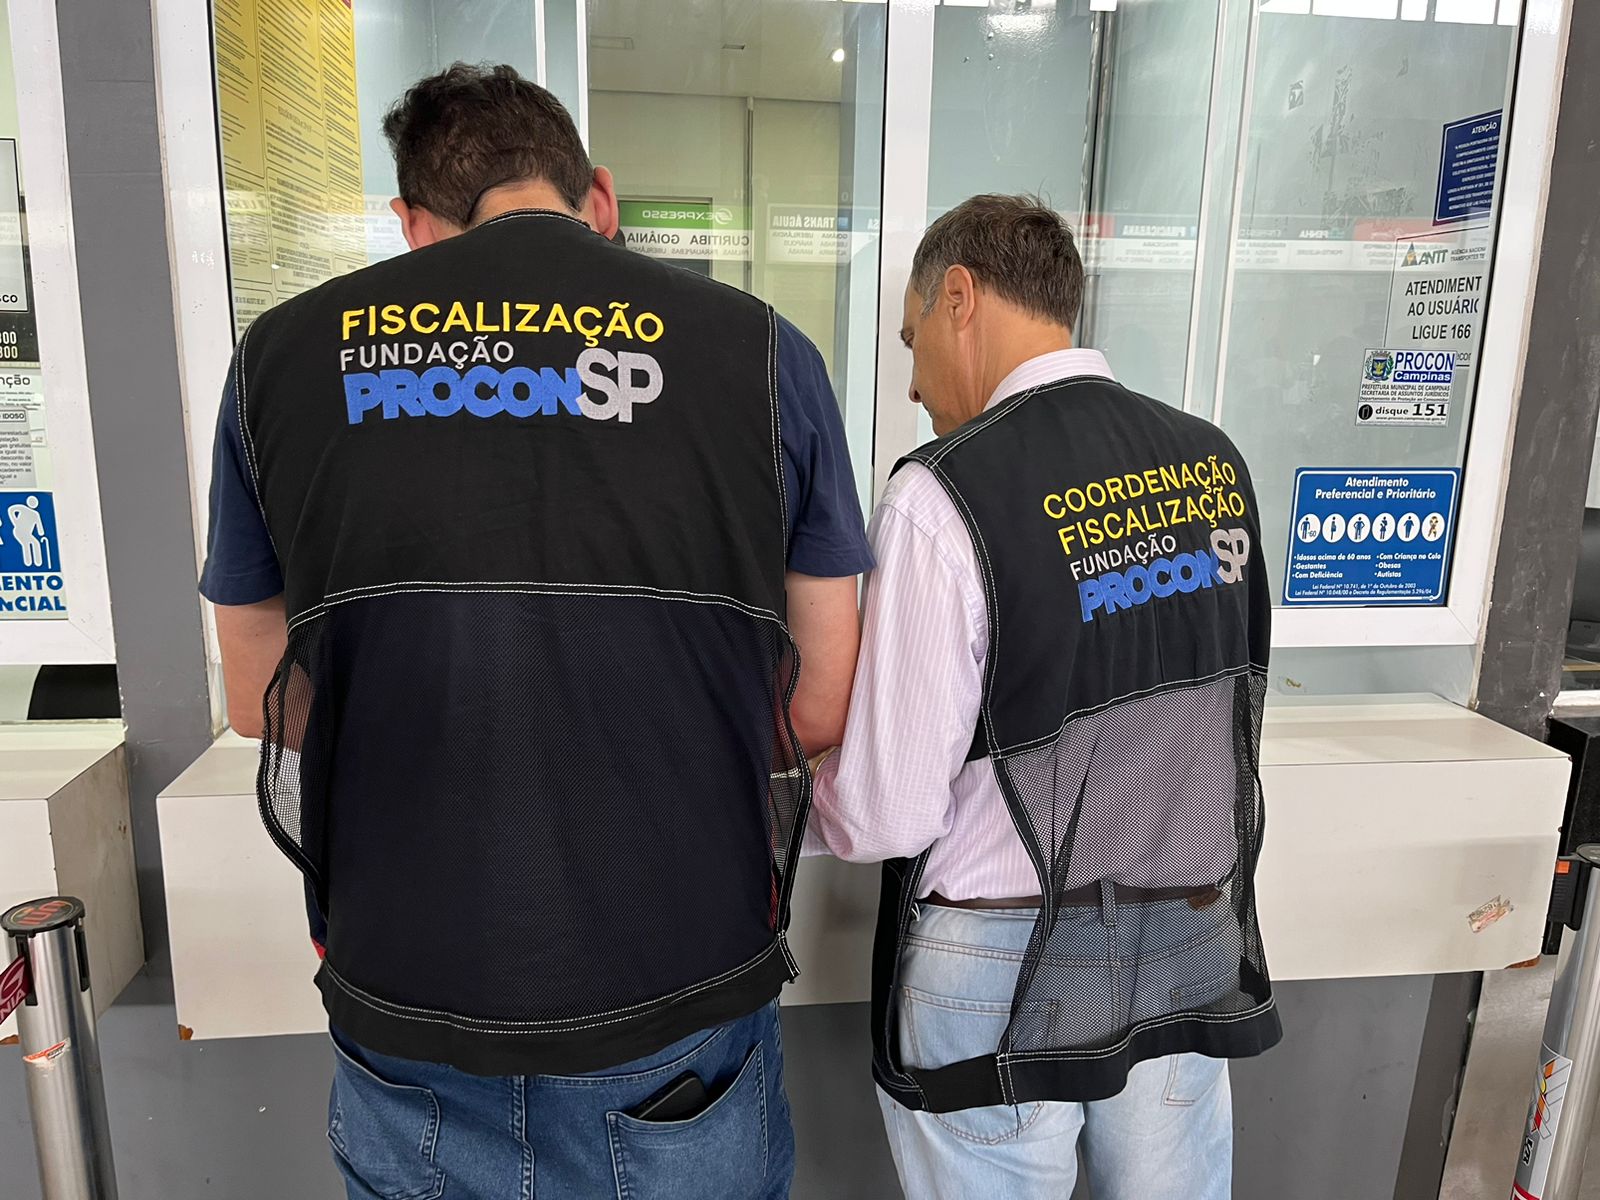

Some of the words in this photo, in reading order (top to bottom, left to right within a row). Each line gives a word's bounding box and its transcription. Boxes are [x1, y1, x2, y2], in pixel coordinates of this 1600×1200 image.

[1471, 121, 1498, 134] ATENÇÃO
[1419, 249, 1448, 264] ANTT
[1405, 276, 1482, 296] ATENDIMENT
[1407, 301, 1424, 316] AO
[342, 301, 664, 347] FISCALIZAÇÃO
[1412, 324, 1448, 340] LIGUE
[1451, 324, 1472, 339] 166
[340, 335, 514, 372] FUNDAÇÃO
[1394, 352, 1455, 370] PROCON
[1394, 371, 1451, 382] Campinas
[1376, 406, 1408, 416] disque
[1412, 404, 1447, 416] 151
[1044, 455, 1236, 520] COORDENAÇÃO
[1344, 476, 1409, 487] Atendimento
[1315, 488, 1375, 499] Preferencial
[1376, 490, 1384, 498] e
[1386, 488, 1436, 499] Prioritário
[1058, 486, 1245, 555] FISCALIZAÇÃO
[1070, 532, 1177, 581] FUNDAÇÃO
[1394, 552, 1418, 561] Criança
